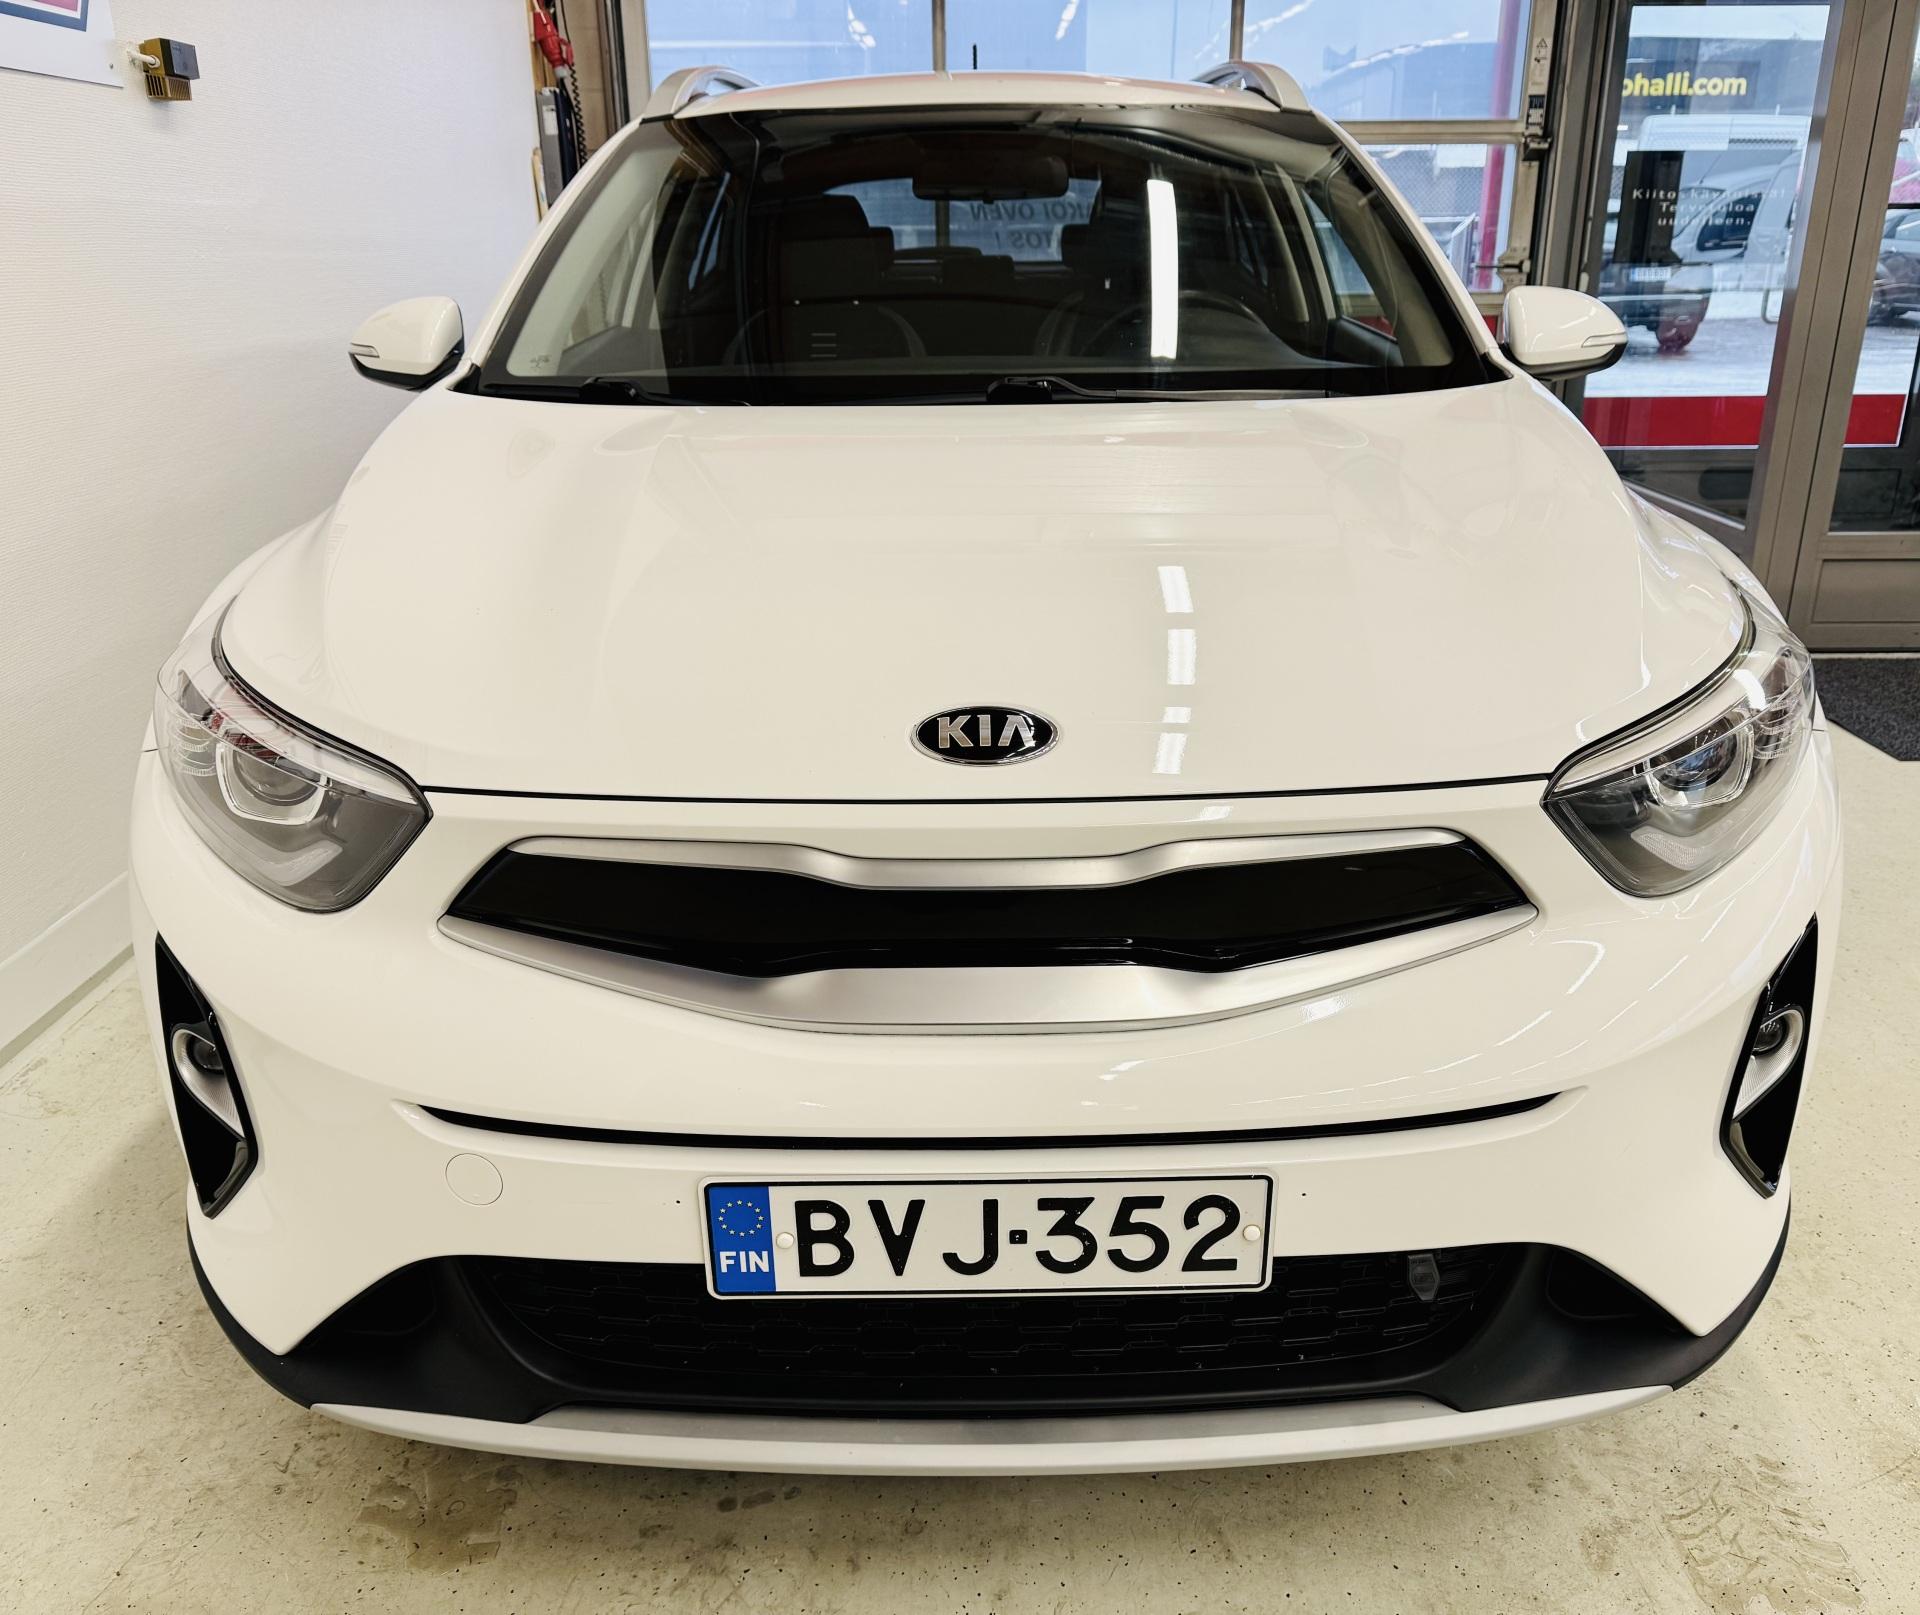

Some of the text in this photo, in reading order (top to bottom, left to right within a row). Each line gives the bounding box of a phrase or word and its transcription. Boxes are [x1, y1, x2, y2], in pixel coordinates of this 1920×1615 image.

[937, 714, 1036, 749] KIA
[794, 1194, 1242, 1278] BVJ-352
[719, 1250, 770, 1274] FIN
